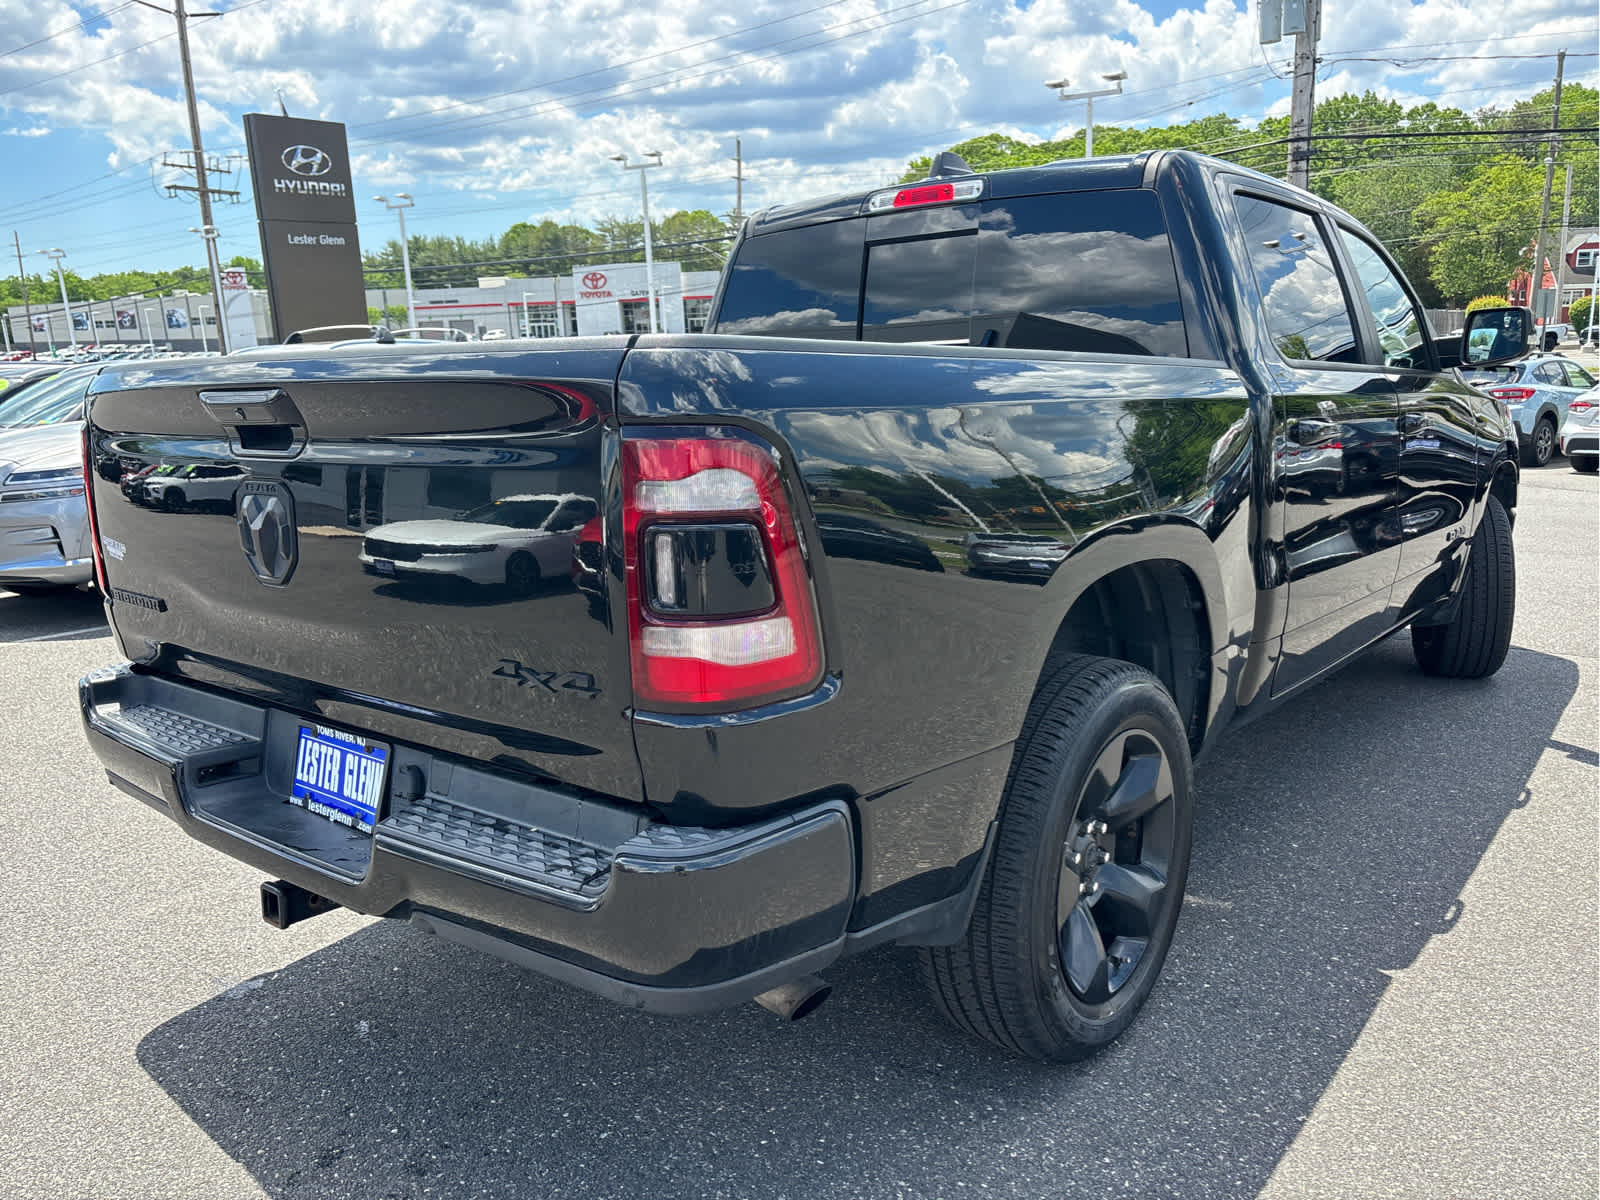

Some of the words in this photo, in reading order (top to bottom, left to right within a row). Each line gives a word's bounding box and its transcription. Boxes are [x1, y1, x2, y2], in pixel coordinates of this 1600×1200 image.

[273, 178, 347, 197] HYUNDAI
[287, 233, 316, 246] Lester
[319, 234, 345, 246] Glenn
[579, 290, 613, 299] TOYOTA
[316, 725, 335, 739] TOMS
[335, 730, 356, 745] RIVER,
[356, 736, 367, 747] NJ
[296, 738, 341, 794] LESTER
[343, 752, 385, 809] GLENN
[308, 800, 352, 827] lesterglenn
